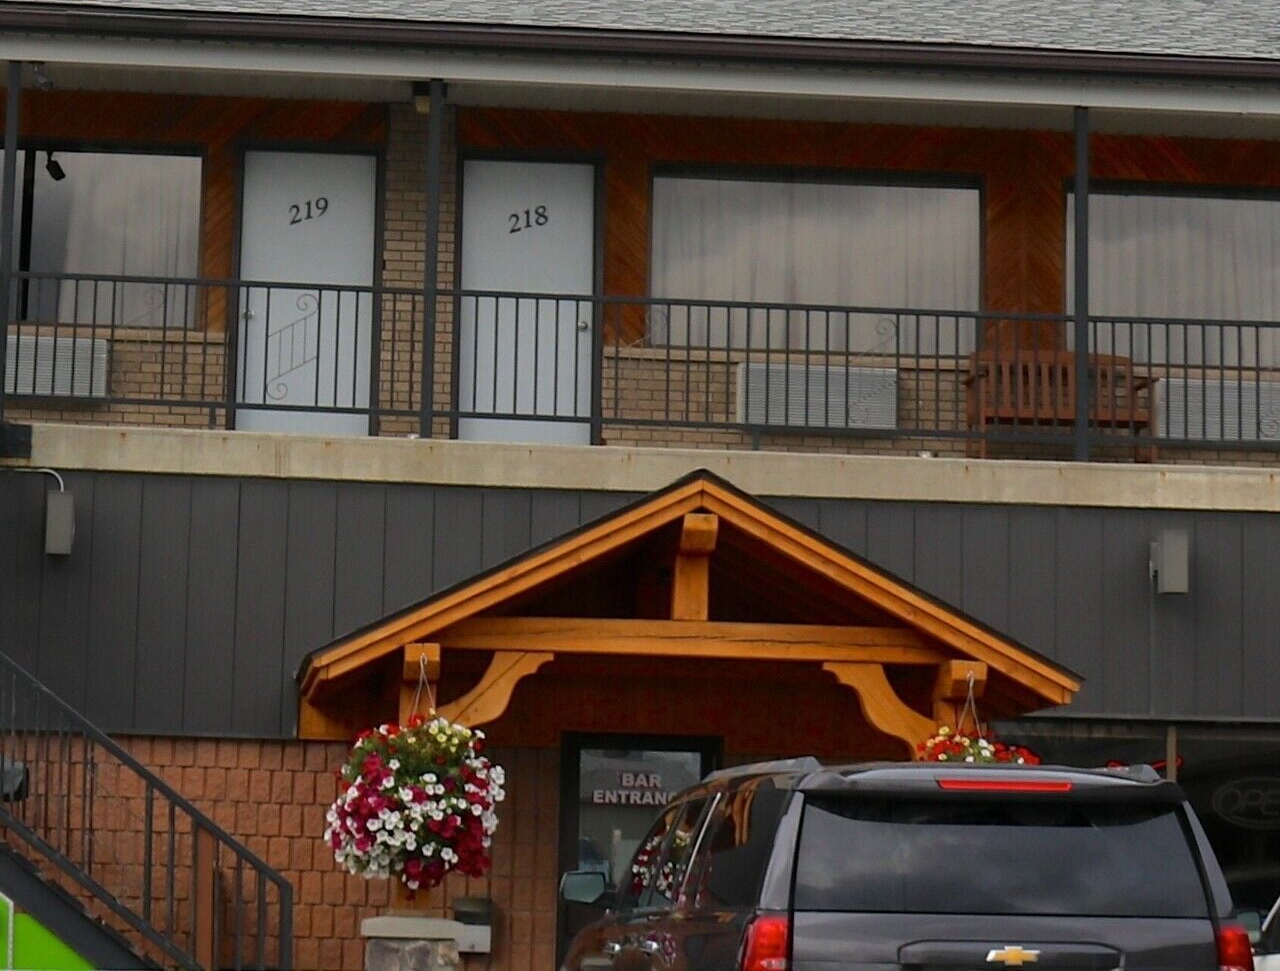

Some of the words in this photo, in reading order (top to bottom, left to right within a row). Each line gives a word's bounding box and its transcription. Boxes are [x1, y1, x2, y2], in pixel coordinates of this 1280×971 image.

[288, 196, 330, 225] 219
[508, 205, 549, 234] 218
[621, 772, 662, 787] BAR
